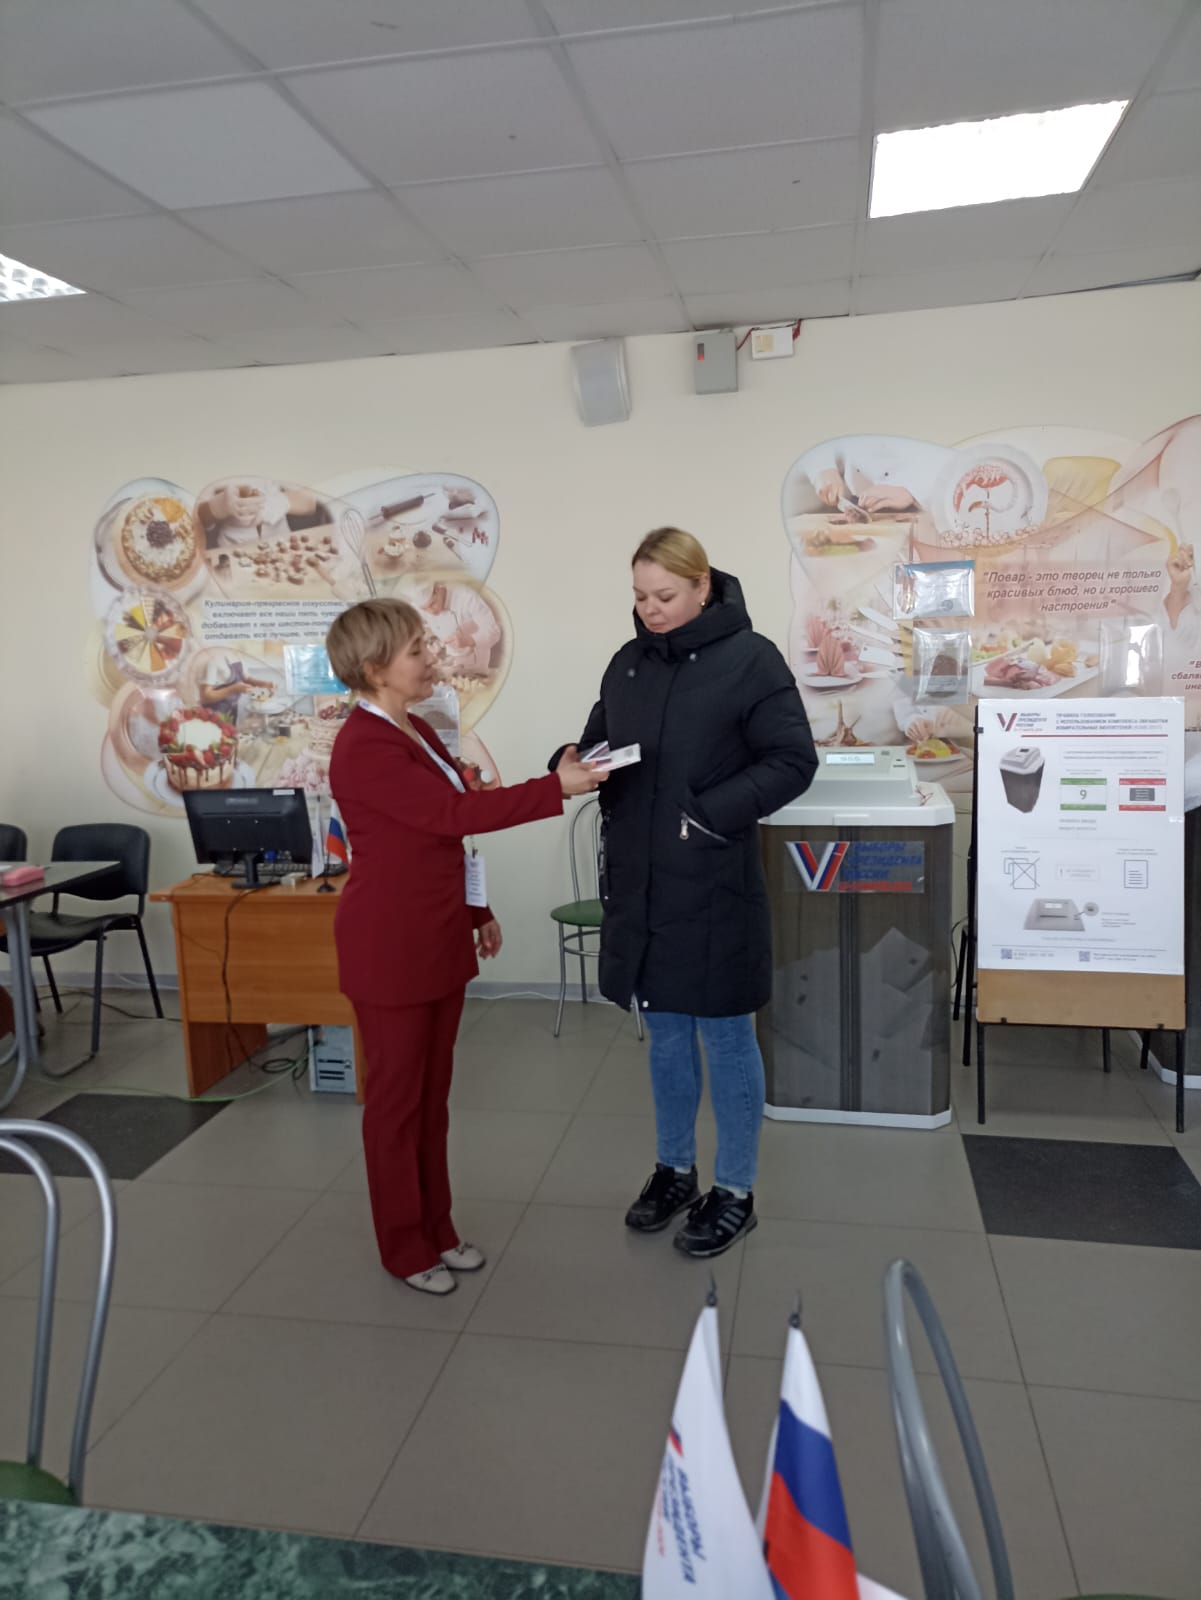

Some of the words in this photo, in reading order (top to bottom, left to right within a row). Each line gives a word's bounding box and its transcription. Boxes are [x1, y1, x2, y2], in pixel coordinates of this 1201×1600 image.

[983, 572, 1026, 583] "Повар
[1035, 573, 1059, 581] это
[1061, 572, 1104, 583] творец
[1122, 570, 1162, 578] только
[986, 588, 1044, 600] красивых
[1047, 586, 1080, 597] блюд,
[1083, 587, 1097, 595] но
[1099, 587, 1106, 595] и
[1108, 584, 1159, 596] хорошего
[1080, 789, 1087, 800] 9
